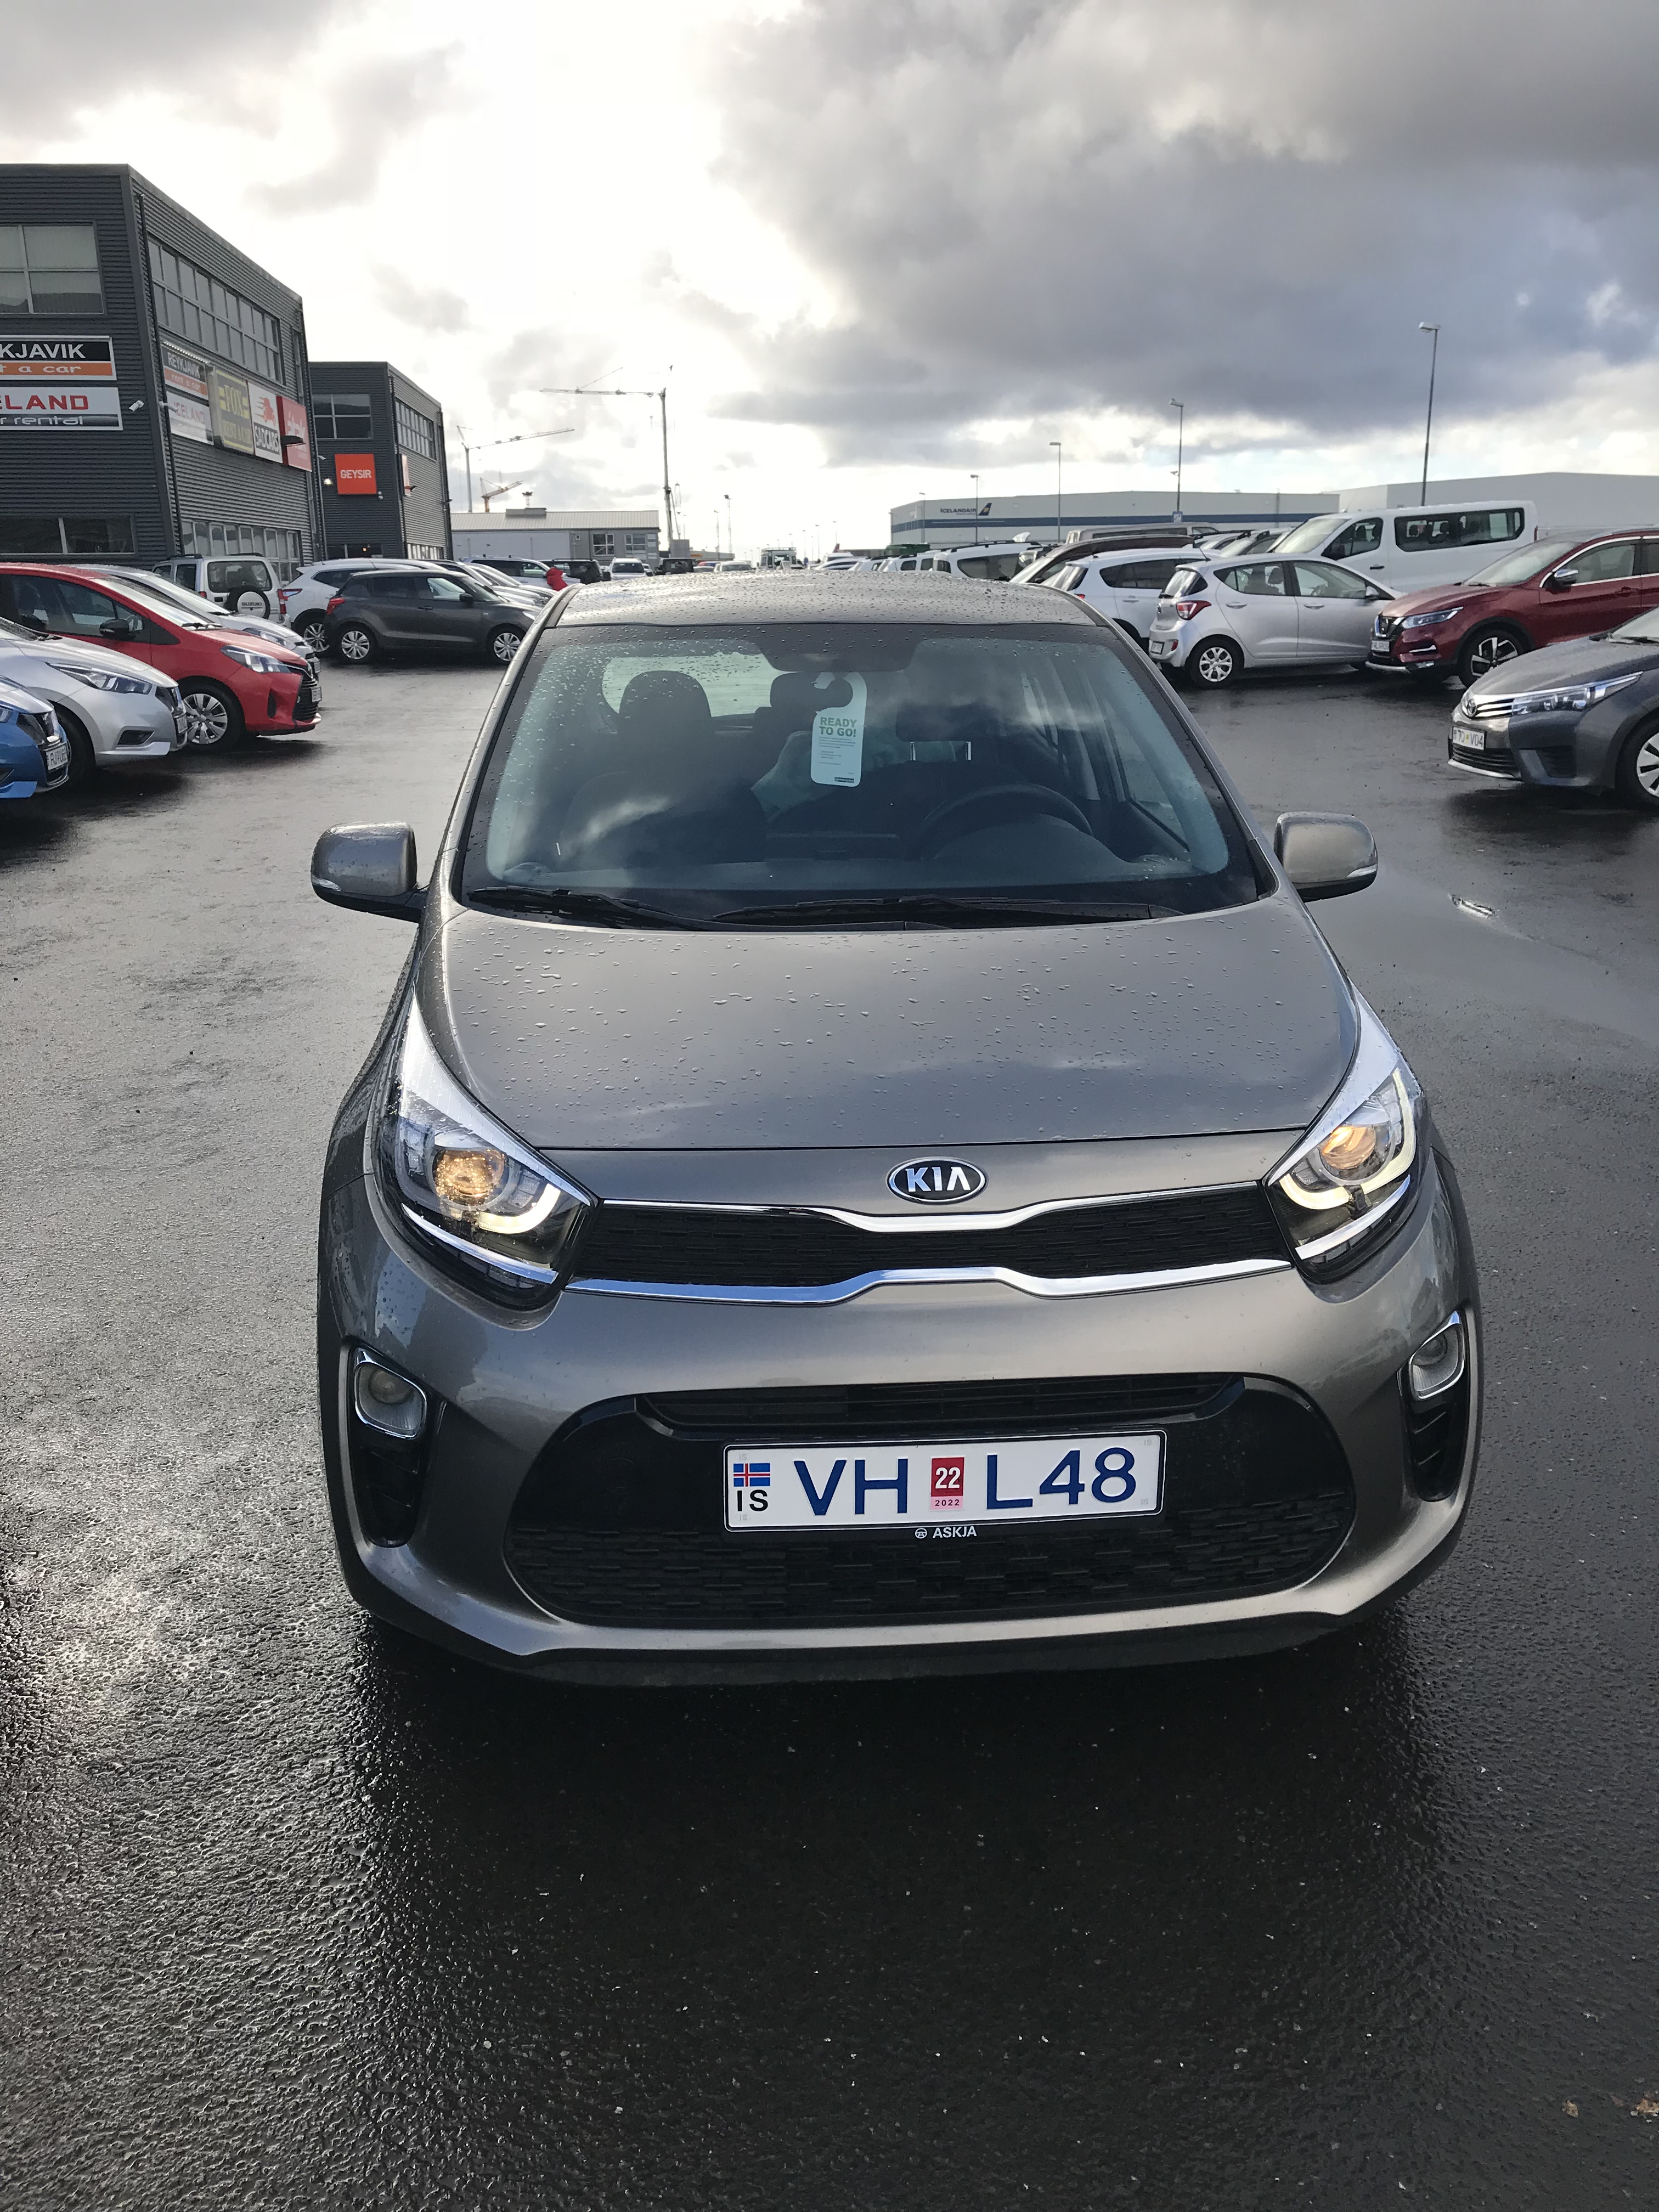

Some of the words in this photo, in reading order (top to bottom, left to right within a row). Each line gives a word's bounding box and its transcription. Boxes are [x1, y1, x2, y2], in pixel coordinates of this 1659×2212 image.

[167, 351, 201, 379] REYKJAVIK
[0, 395, 89, 410] LAND
[224, 384, 243, 416] FOX
[14, 416, 83, 425] rental
[255, 425, 279, 453] SADCARS
[340, 470, 371, 479] GEYSIR
[819, 726, 834, 736] TO
[837, 727, 857, 737] GO!
[820, 716, 857, 728] READY
[905, 1166, 971, 1192] KIA
[793, 1458, 909, 1516] VH
[986, 1447, 1136, 1510] L48
[935, 1466, 961, 1489] 22
[737, 1489, 769, 1512] IS
[933, 1526, 977, 1538] ASKJA
